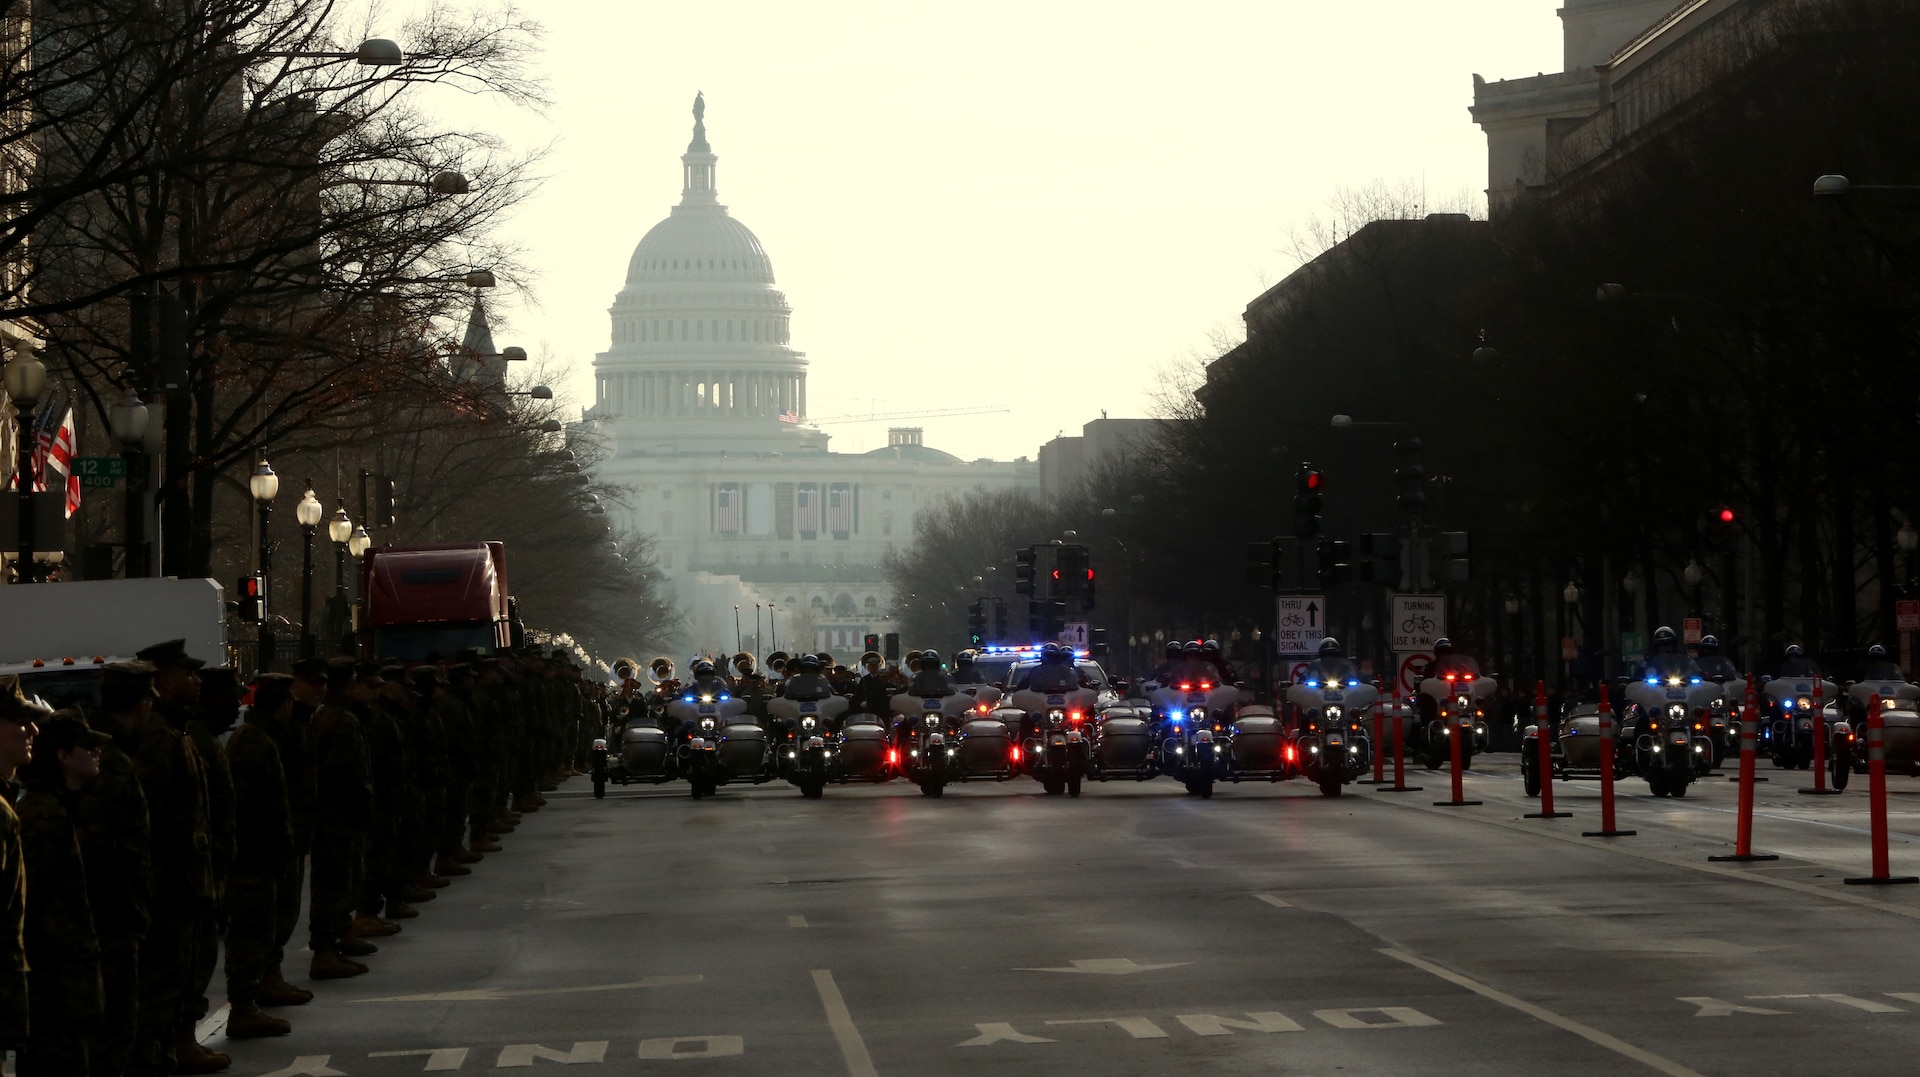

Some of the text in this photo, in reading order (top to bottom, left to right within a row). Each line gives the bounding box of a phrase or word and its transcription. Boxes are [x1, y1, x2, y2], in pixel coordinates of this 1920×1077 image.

[80, 460, 98, 475] 12
[85, 476, 111, 486] 400
[1281, 600, 1302, 610] THRU
[1404, 601, 1435, 611] TURNING
[1280, 630, 1322, 640] OBEY THIS
[1281, 641, 1309, 651] SIGNAL
[1394, 636, 1436, 646] USE X-WAL
[955, 1006, 1445, 1047] ONLY
[256, 1035, 745, 1077] ONLY
